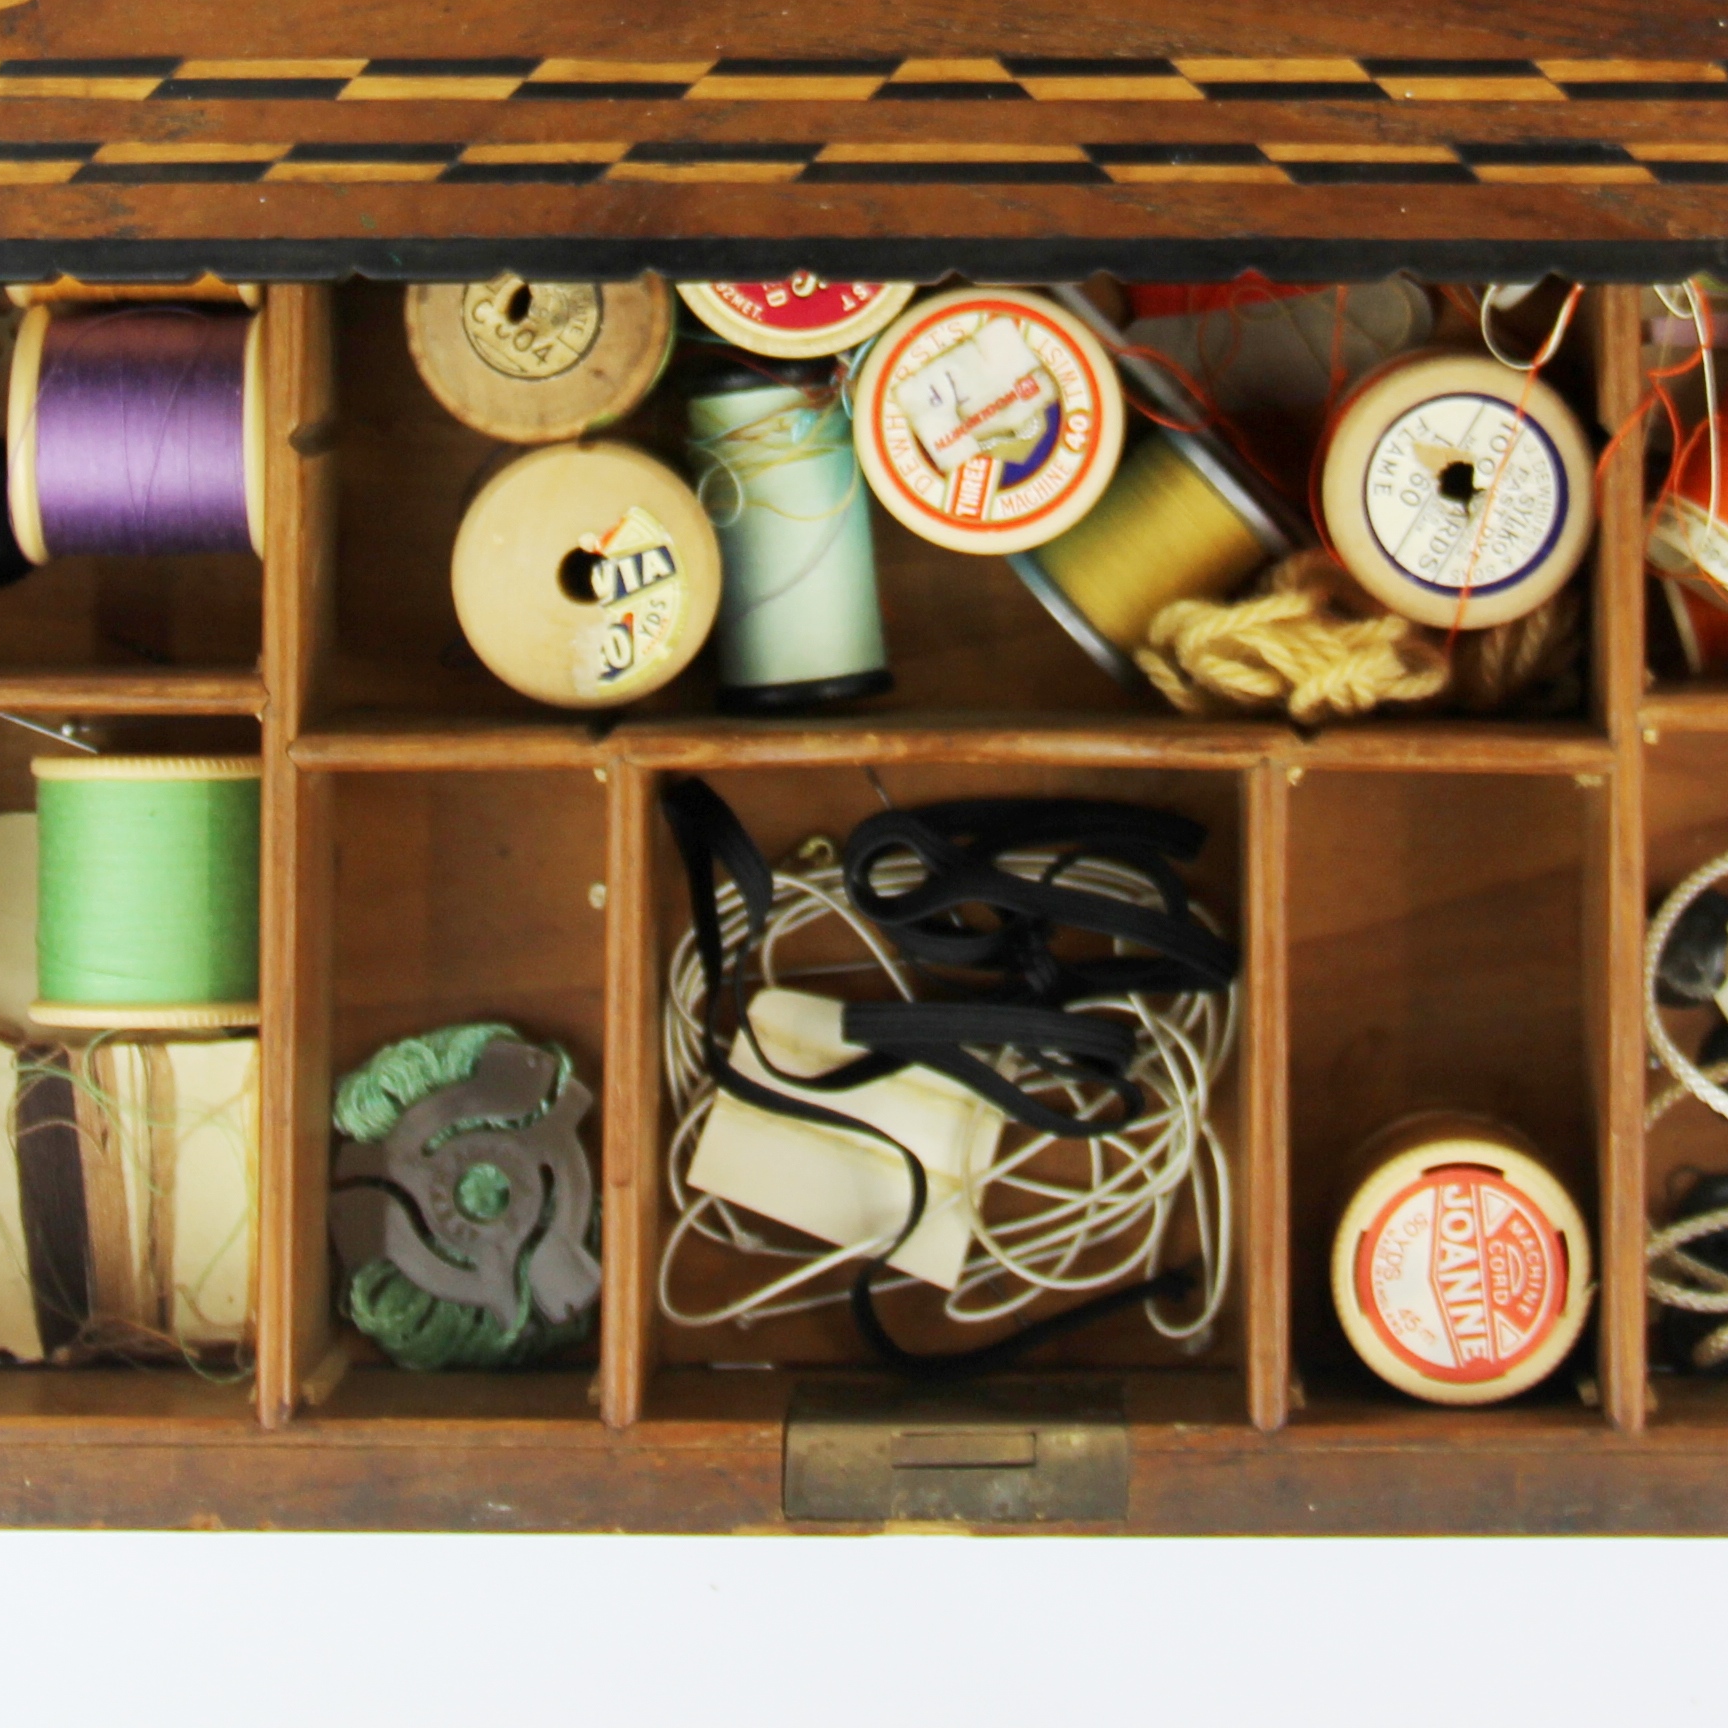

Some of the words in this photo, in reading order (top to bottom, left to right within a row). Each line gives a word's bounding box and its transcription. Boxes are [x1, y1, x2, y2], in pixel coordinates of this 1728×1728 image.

[1035, 337, 1085, 404] TWIST
[885, 320, 968, 497] DEWHRST'S
[1065, 412, 1090, 452] 40
[1374, 416, 1430, 497] FLAME
[1476, 421, 1517, 476] 100
[955, 456, 990, 516] THREE
[1000, 458, 1072, 517] MACHINE
[1399, 472, 1428, 507] 60
[1491, 493, 1535, 555] SYLKO
[638, 598, 668, 639] YDS
[1439, 1183, 1488, 1362] JOANNE
[1487, 1239, 1513, 1306] CORD
[1508, 1219, 1543, 1316] MACHINE
